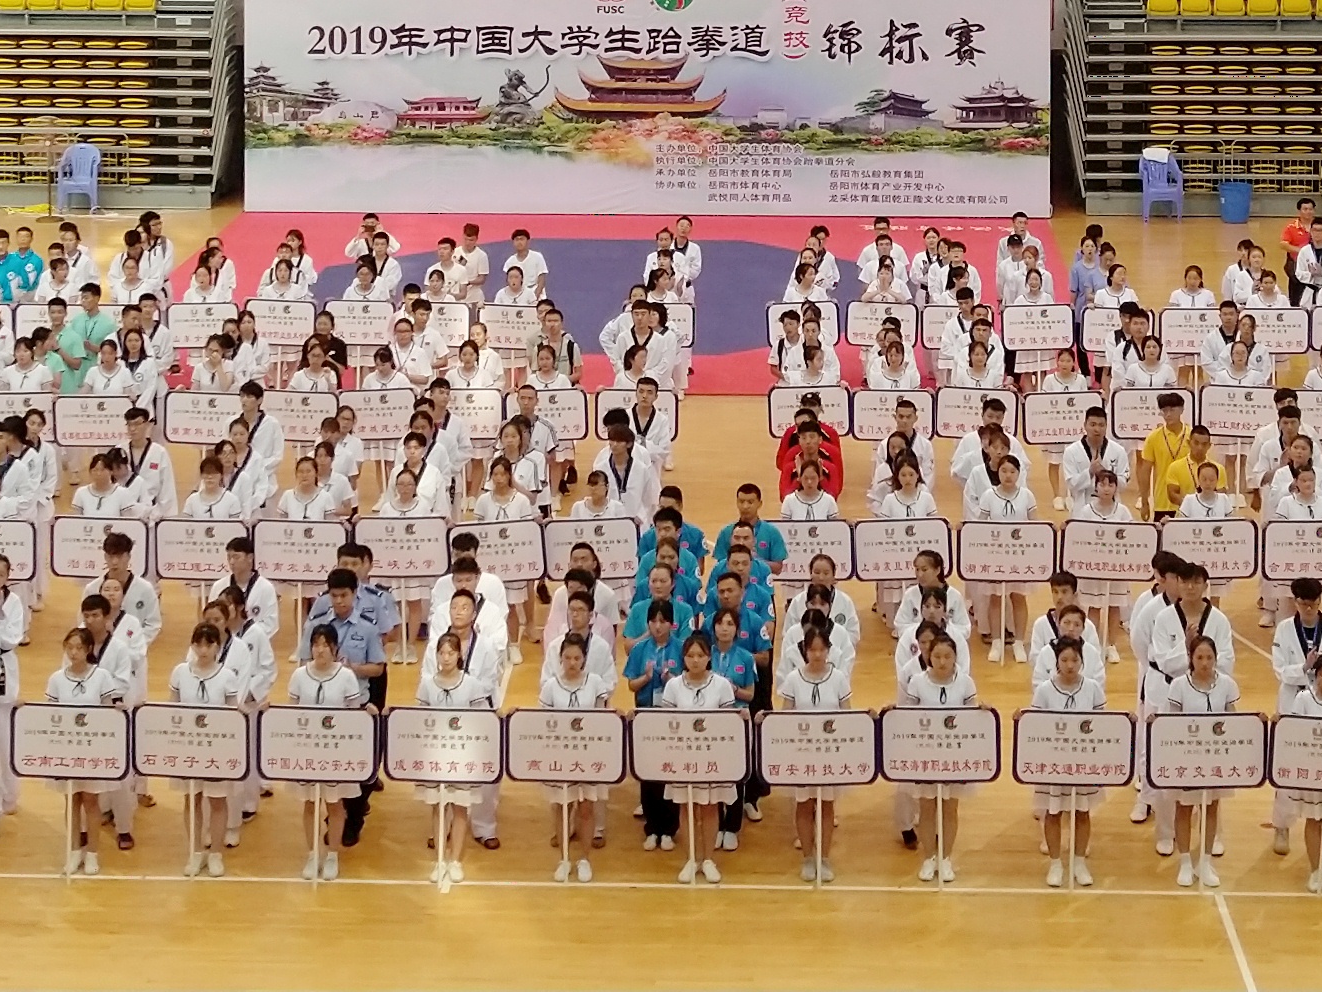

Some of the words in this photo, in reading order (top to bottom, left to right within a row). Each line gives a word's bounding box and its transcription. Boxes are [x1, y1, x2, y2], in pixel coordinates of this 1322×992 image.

[596, 5, 624, 14] FUSC
[307, 23, 771, 59] 2019年中国大学生跆拳道
[822, 17, 987, 68] 锦标赛
[22, 754, 120, 769] 云南工商学院
[142, 754, 242, 769] 石河子大学
[267, 757, 369, 772] 中国人民公安大学
[393, 759, 496, 774] 成都体育学院
[526, 759, 607, 774] 燕山大学
[661, 760, 720, 774] 裁判员
[889, 758, 993, 773] 江苏海事职业技术学院
[1021, 762, 1127, 776] 天津交通职业学院
[769, 762, 870, 777] 西安科技大学
[1157, 763, 1258, 779] 北京交通大学
